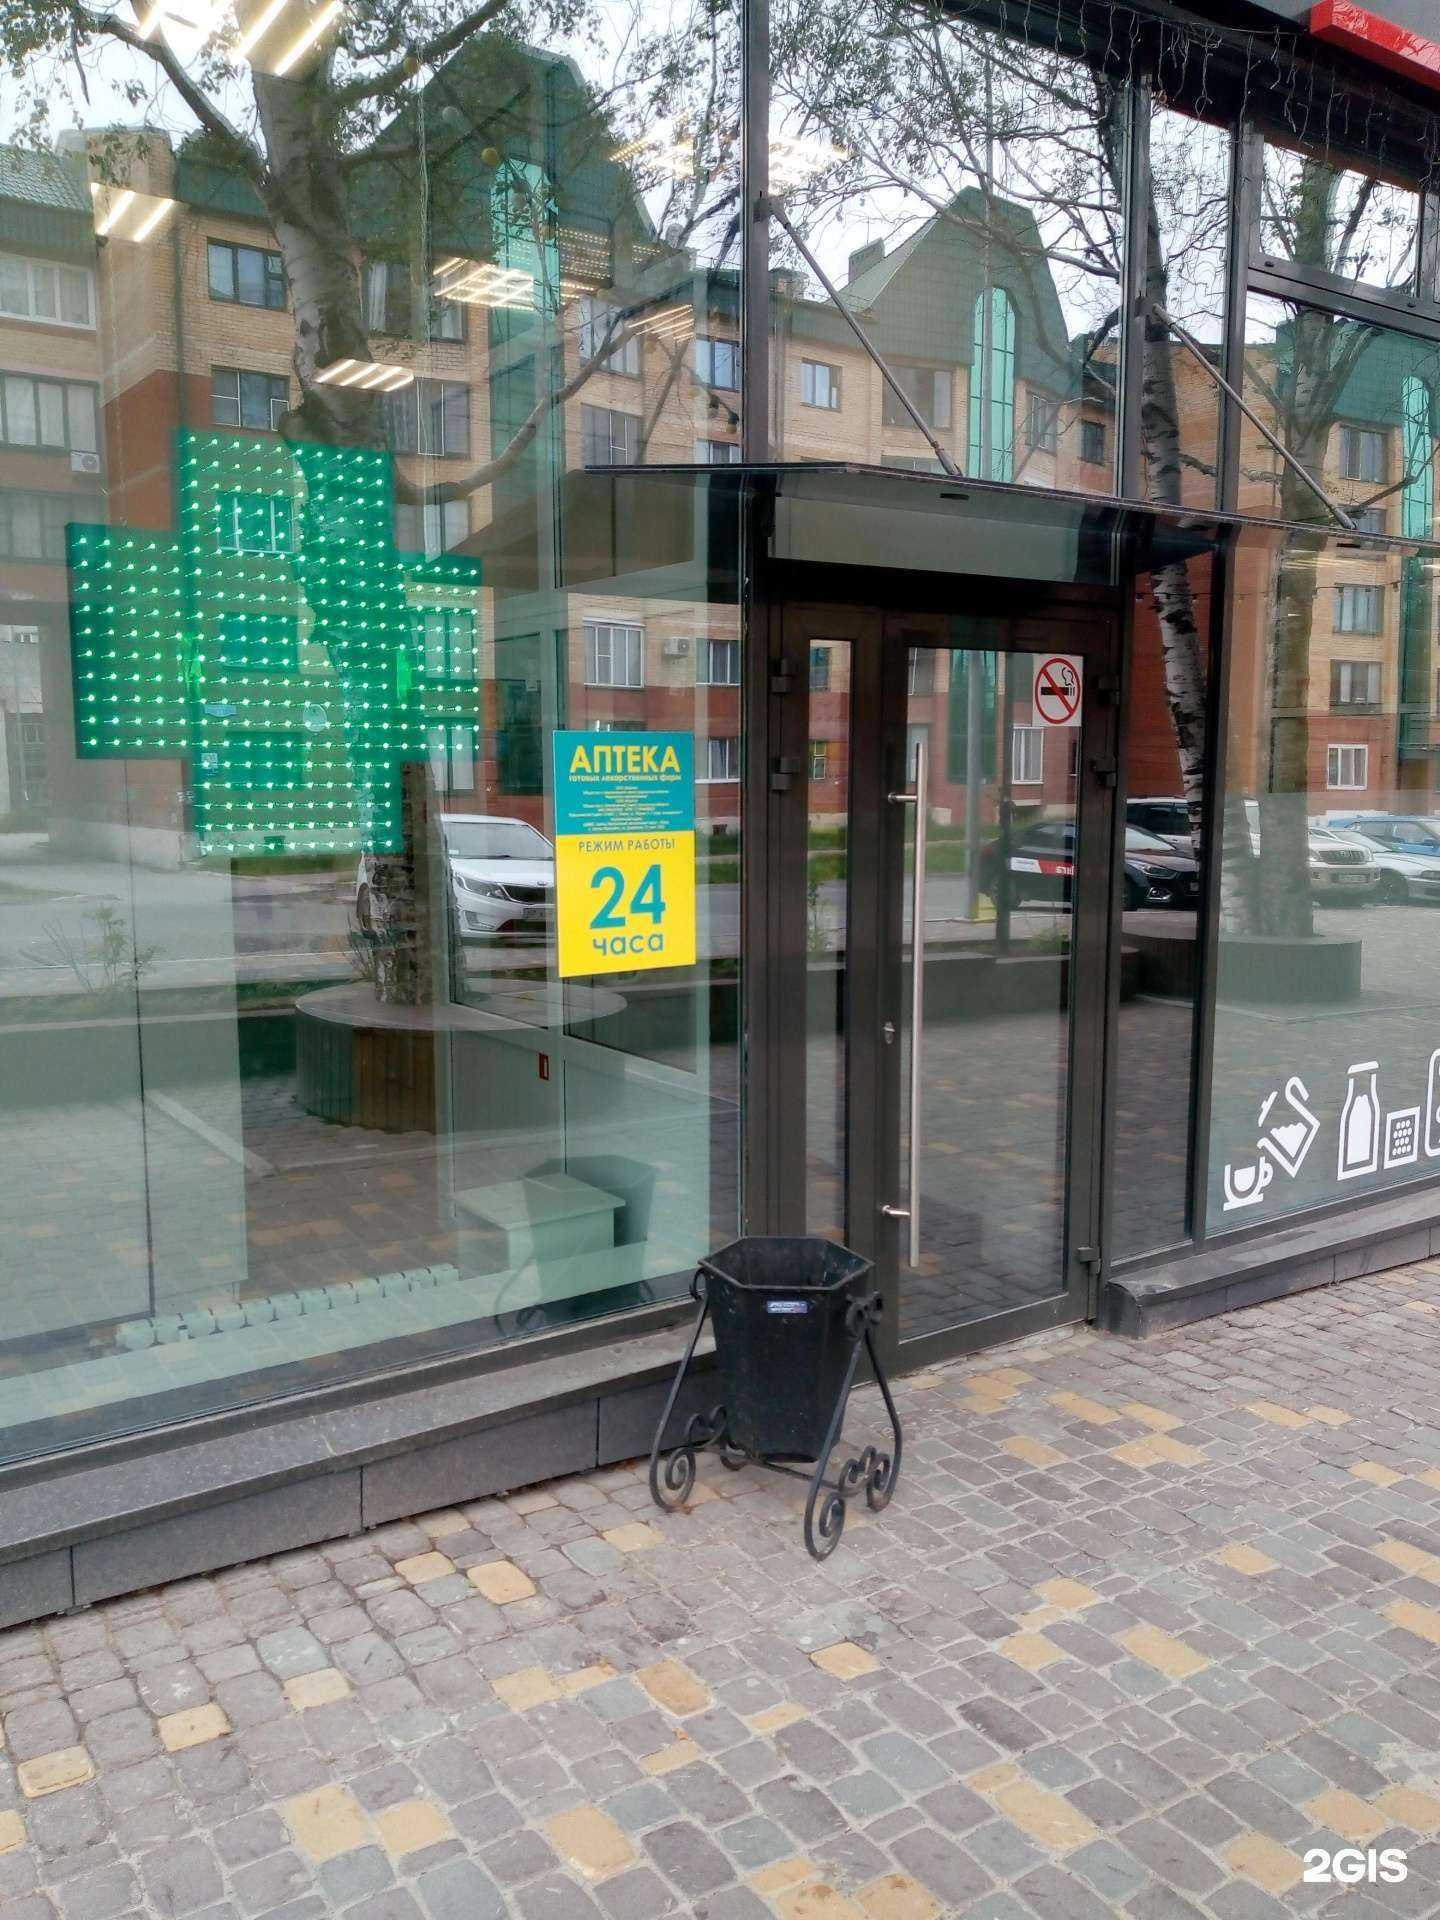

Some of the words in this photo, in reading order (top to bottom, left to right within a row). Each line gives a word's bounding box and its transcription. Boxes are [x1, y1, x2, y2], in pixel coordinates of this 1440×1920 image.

[570, 745, 681, 773] АПТЕКА
[578, 840, 624, 853] РЕЖИМ
[628, 838, 676, 850] РАБОТЫ
[590, 864, 666, 929] 24
[593, 933, 664, 956] часа
